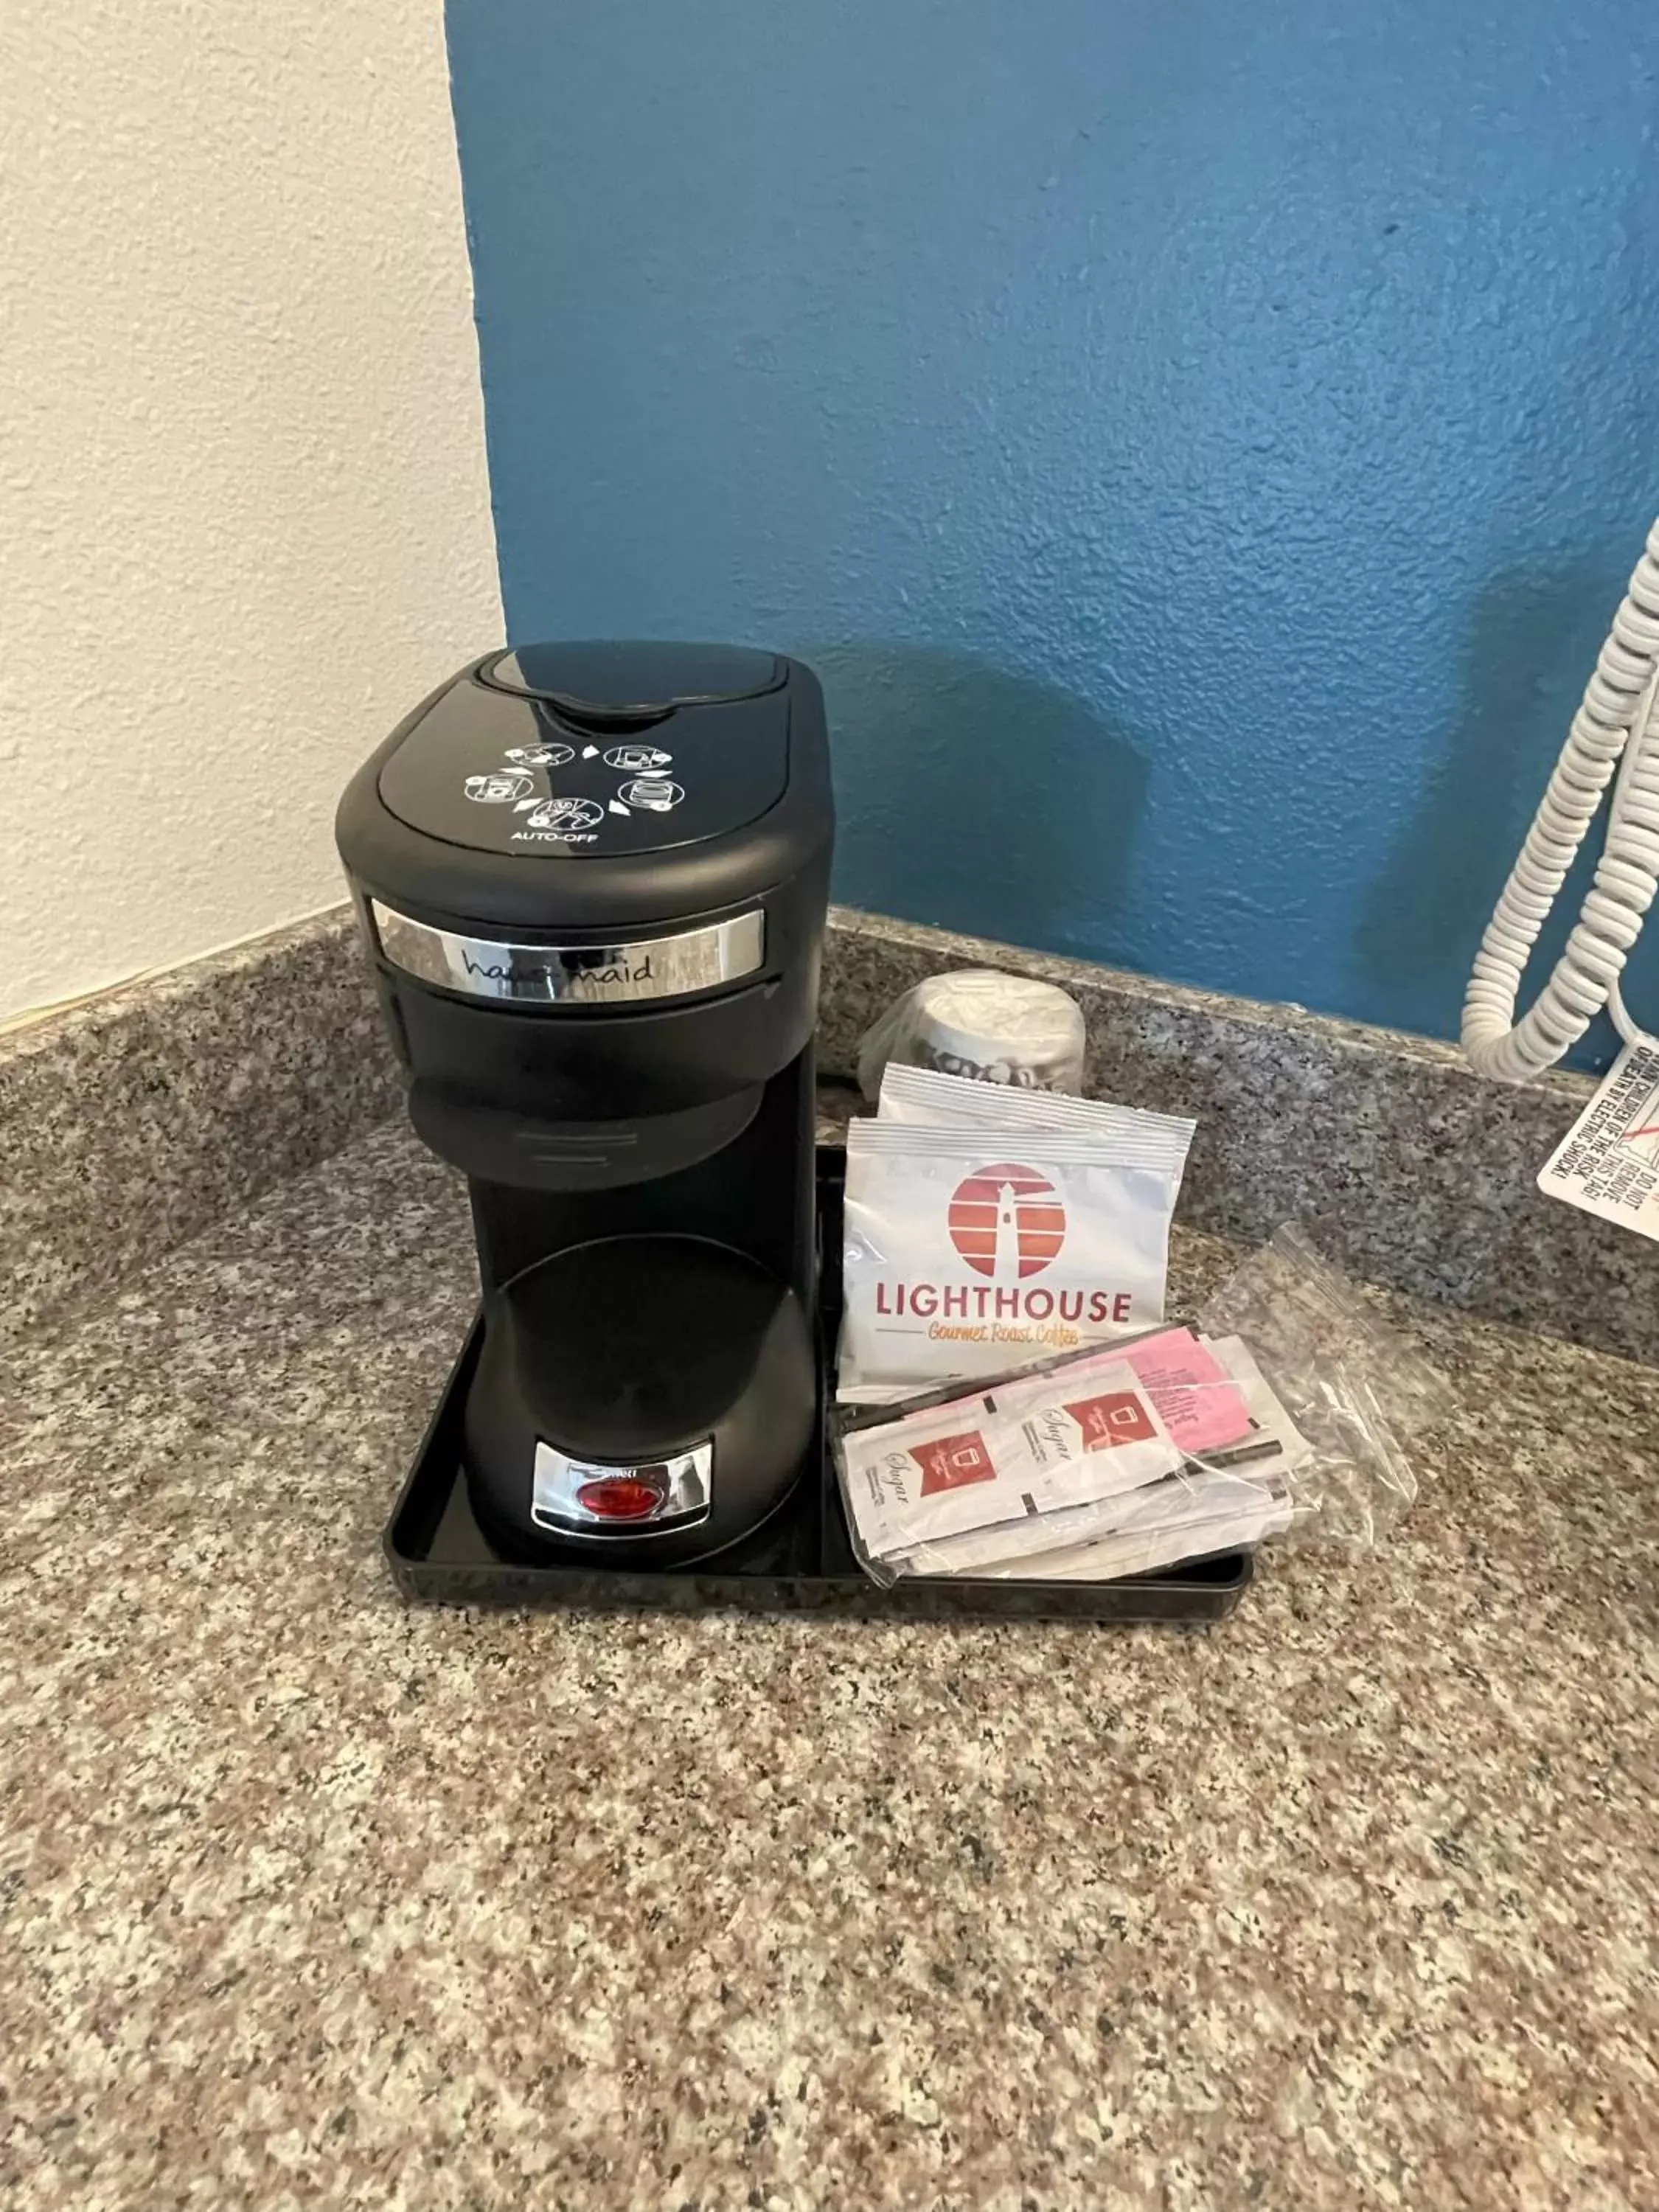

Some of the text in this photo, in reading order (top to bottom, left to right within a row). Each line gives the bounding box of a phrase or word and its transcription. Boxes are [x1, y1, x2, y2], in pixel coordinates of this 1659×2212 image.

[510, 831, 599, 843] AUTO-OFF
[1551, 1046, 1653, 1179] OF DEATH BY ELECTRIC SHOCK!
[1613, 1082, 1651, 1124] CHILDREN
[1590, 1135, 1615, 1156] THE
[1605, 1121, 1623, 1137] OF
[1571, 1153, 1600, 1180] RISK
[1581, 1154, 1624, 1201] THIS TAG!
[1602, 1161, 1641, 1204] REMOVE
[1623, 1172, 1658, 1210] DO NOT
[875, 1281, 1132, 1322] LIGHTHOUSE
[928, 1321, 1080, 1348] Gourmet Roast Coffee
[1038, 1408, 1072, 1461] Sugar
[880, 1451, 912, 1504] Sugar
